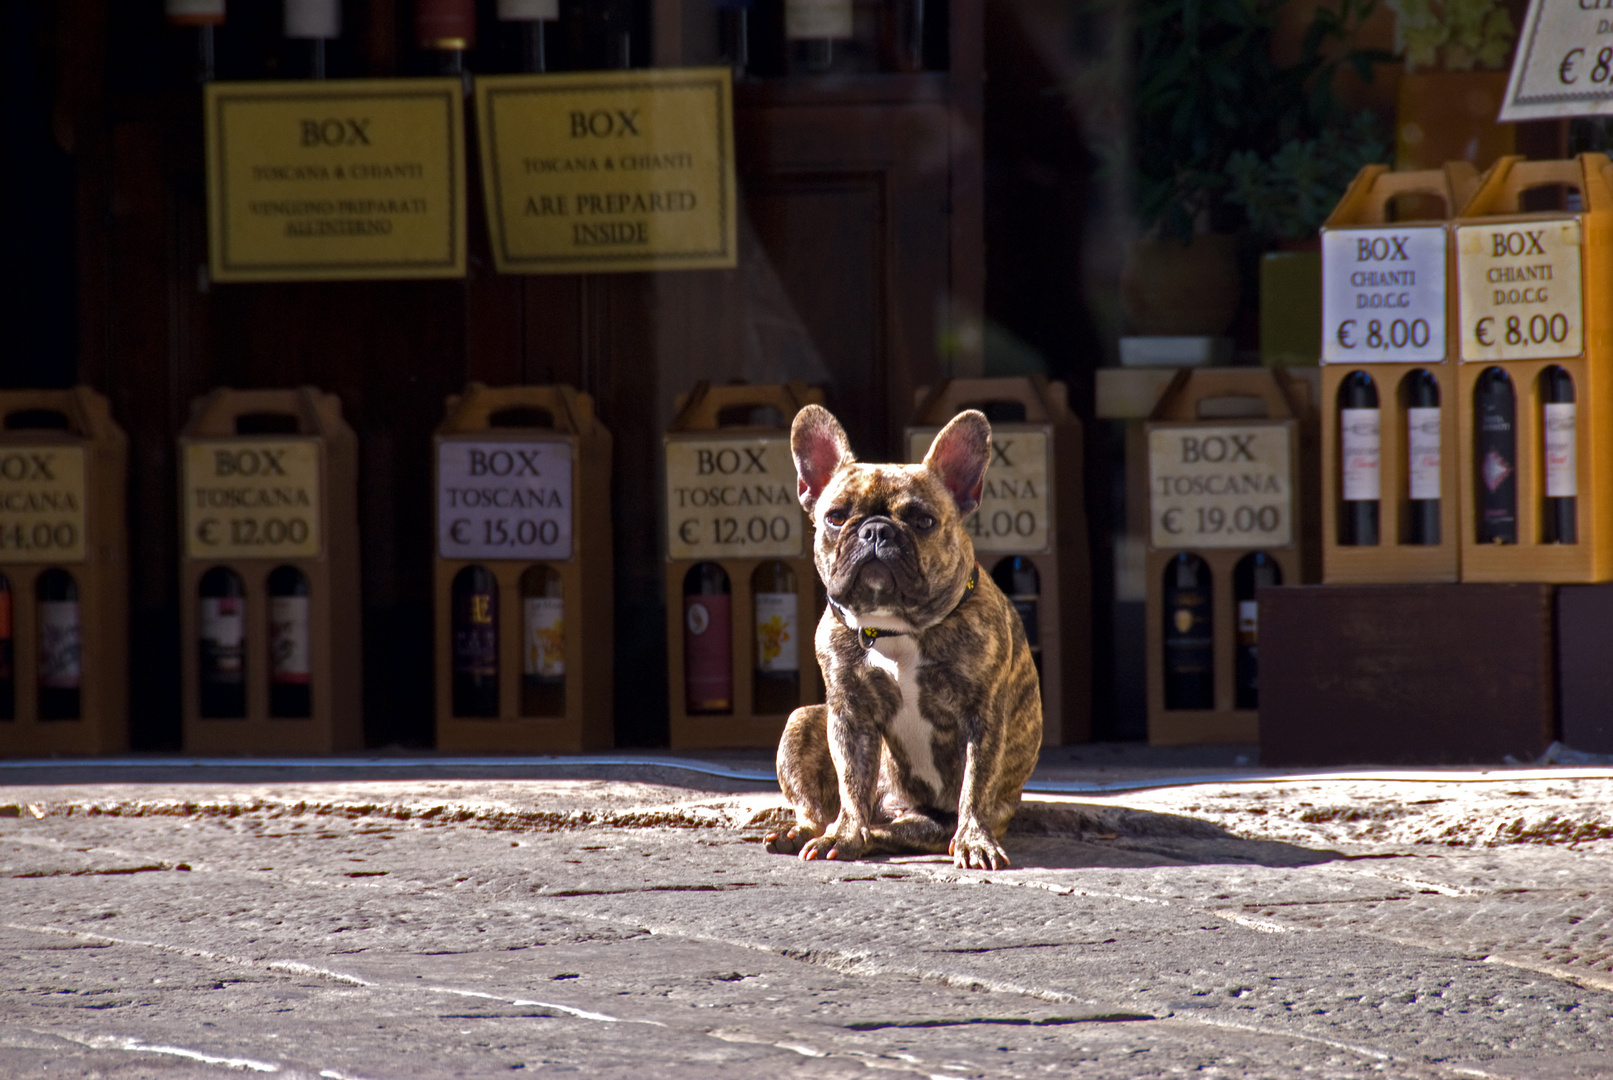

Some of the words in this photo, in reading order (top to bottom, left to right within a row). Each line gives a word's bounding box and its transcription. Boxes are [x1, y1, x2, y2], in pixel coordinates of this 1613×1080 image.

[1558, 47, 1584, 85] €
[300, 118, 371, 147] BOX
[570, 109, 640, 138] BOX
[524, 156, 598, 173] TOSCANA
[604, 157, 614, 170] &
[620, 152, 693, 171] CHIANTI
[525, 196, 568, 216] ARE
[576, 190, 698, 215] PREPARED
[573, 221, 648, 244] INSIDE
[1491, 230, 1546, 258] BOX
[1356, 236, 1410, 262] BOX
[1351, 270, 1416, 288] CHIANTI
[1486, 264, 1553, 284] CHIANTI
[1337, 319, 1357, 349] €
[1366, 318, 1430, 351] 8,00
[1475, 316, 1496, 347] €
[1505, 312, 1569, 348] 8,00
[215, 448, 286, 477] BOX
[696, 447, 768, 475] BOX
[1182, 435, 1257, 463] BOX
[468, 450, 540, 477] BOX
[196, 486, 310, 508] TOSCANA
[445, 487, 563, 508] TOSCANA
[674, 485, 793, 507] TOSCANA
[1158, 474, 1281, 497] TOSCANA
[0, 491, 79, 513] CANA
[196, 517, 220, 547] €
[450, 518, 471, 545] €
[484, 518, 560, 548] 15,00
[679, 518, 700, 545] €
[1161, 507, 1183, 535] €
